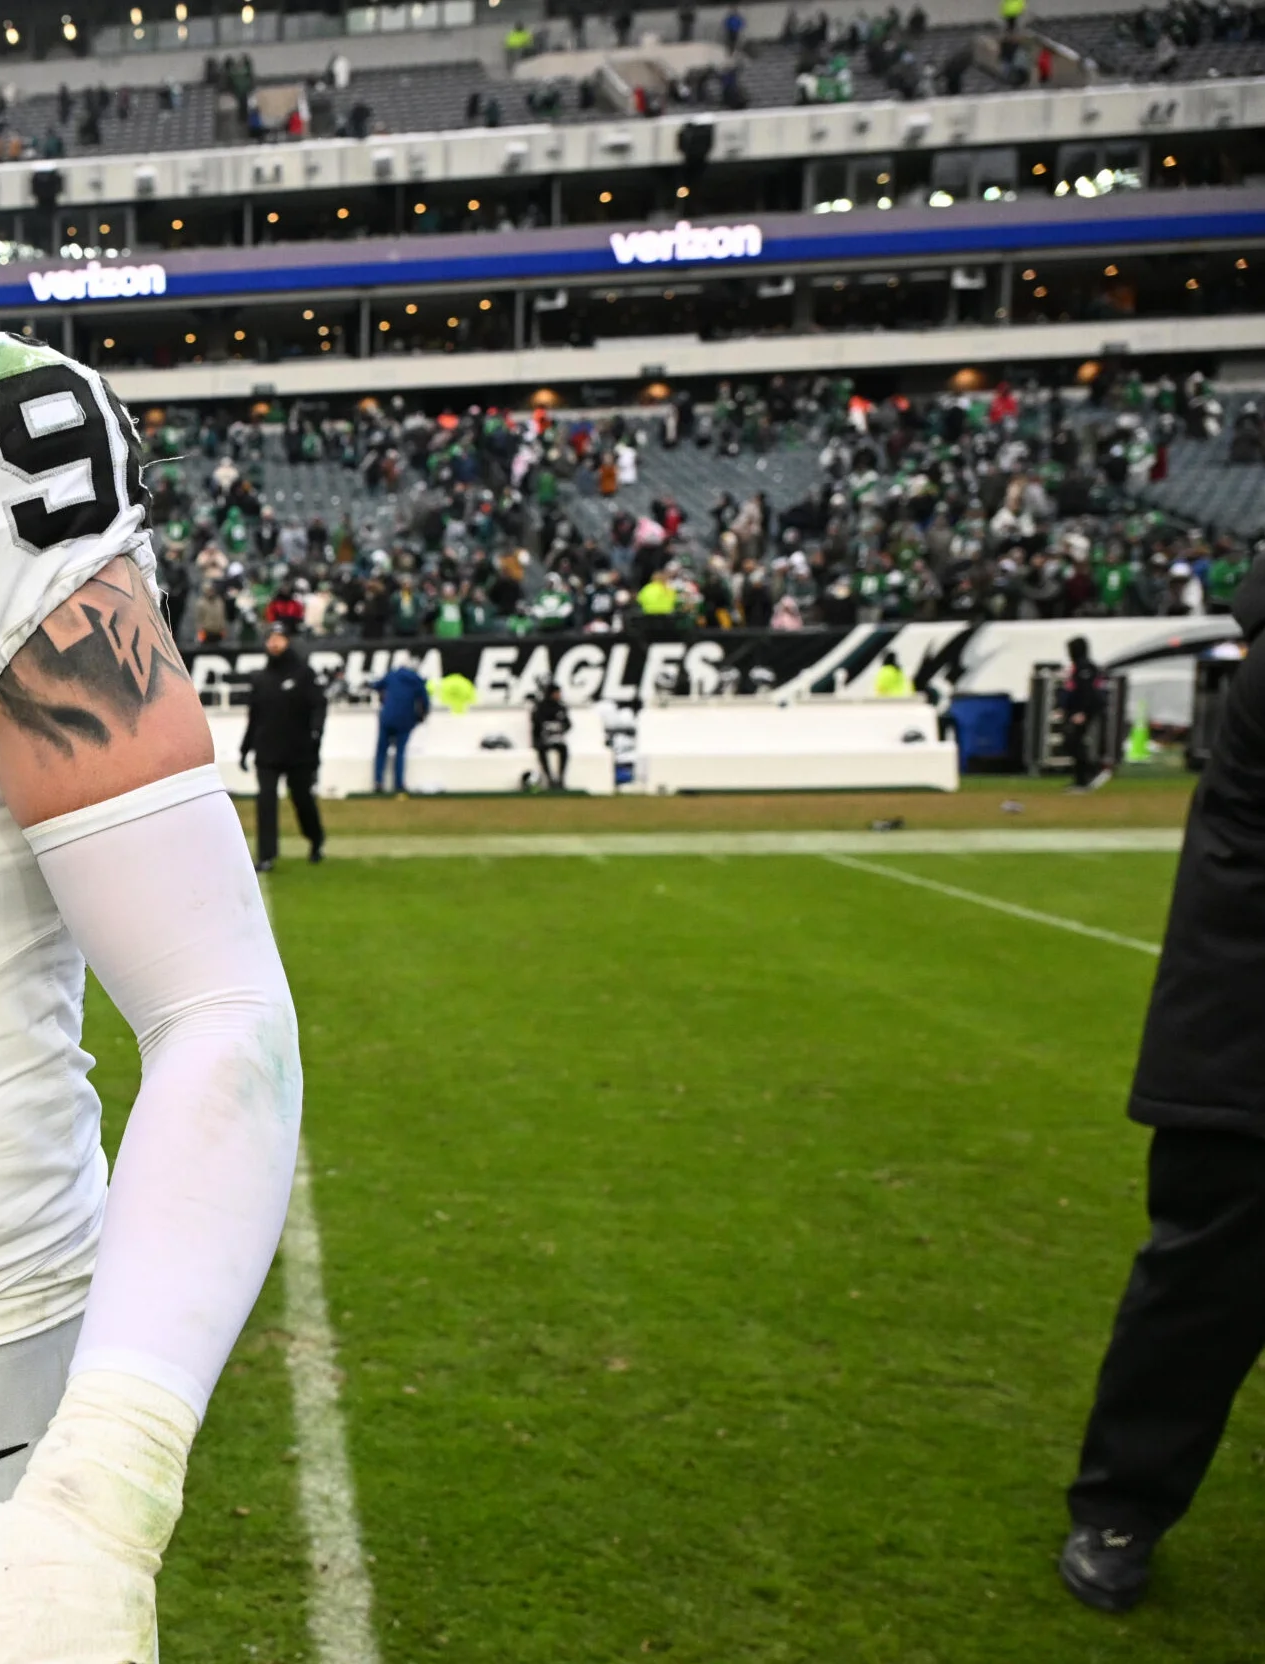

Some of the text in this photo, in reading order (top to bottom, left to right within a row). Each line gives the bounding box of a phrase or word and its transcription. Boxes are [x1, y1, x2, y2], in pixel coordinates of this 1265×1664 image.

[610, 220, 762, 264] verizon
[28, 260, 166, 301] verizon
[473, 641, 724, 705] EAGLES
